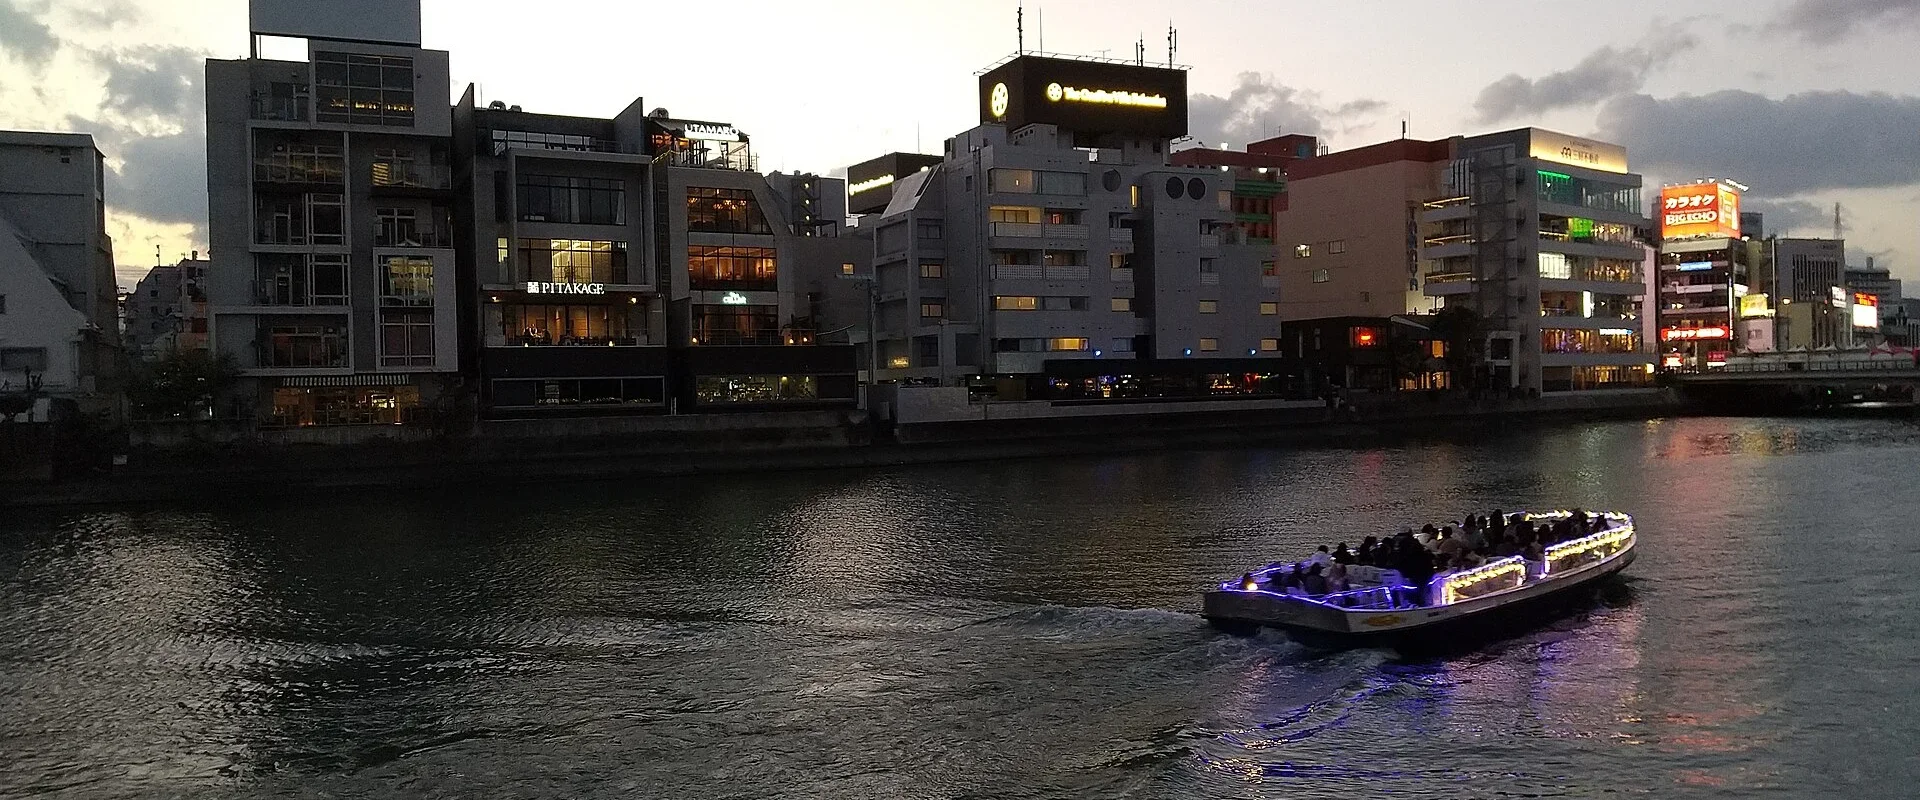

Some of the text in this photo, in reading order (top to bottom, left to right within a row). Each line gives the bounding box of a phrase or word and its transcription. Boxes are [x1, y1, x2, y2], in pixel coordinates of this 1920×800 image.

[685, 124, 739, 136] UTAMARO
[1665, 194, 1715, 209] カラオケ
[542, 283, 605, 295] PITAKAGE
